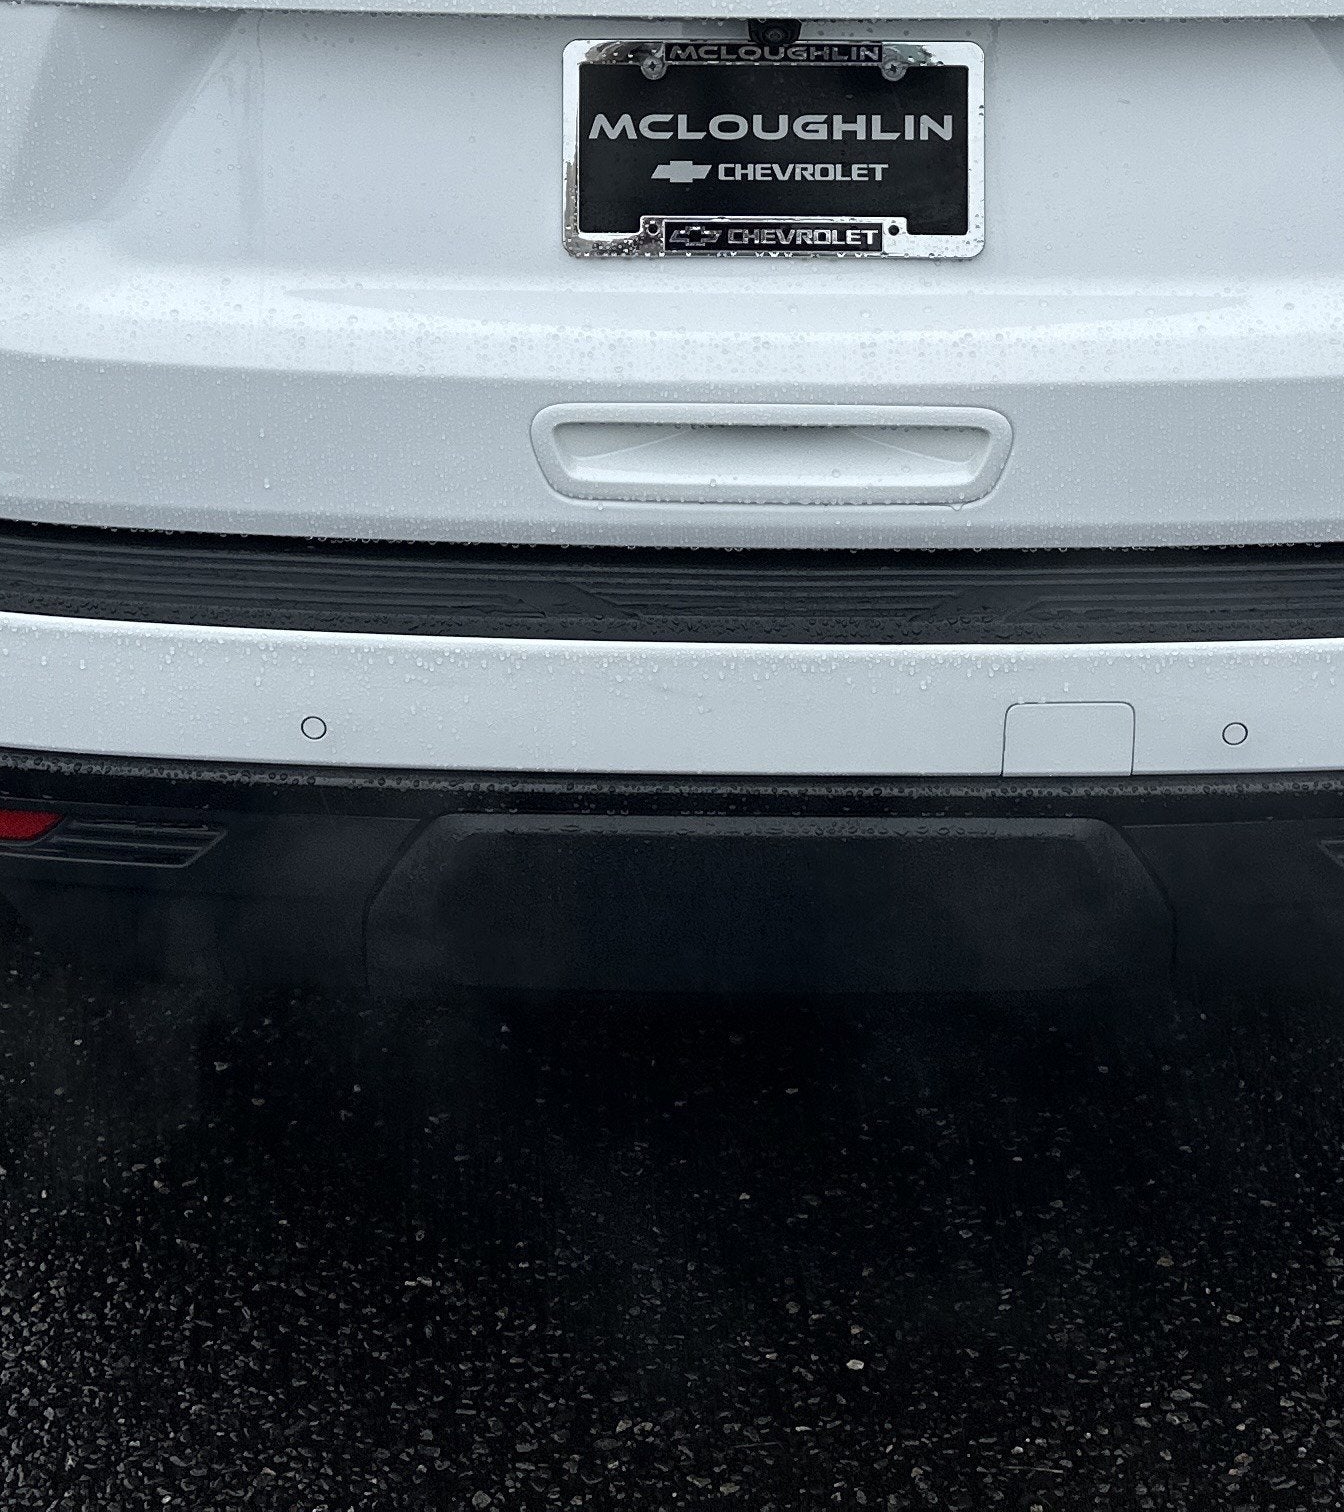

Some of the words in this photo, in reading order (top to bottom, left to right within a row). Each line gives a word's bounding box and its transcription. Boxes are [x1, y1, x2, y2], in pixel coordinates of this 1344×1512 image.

[669, 45, 880, 62] MCLOUGHLIN
[588, 113, 954, 142] MCLOUGHLIN
[717, 163, 889, 182] CHEVROLET
[727, 228, 879, 246] CHEVROLET
